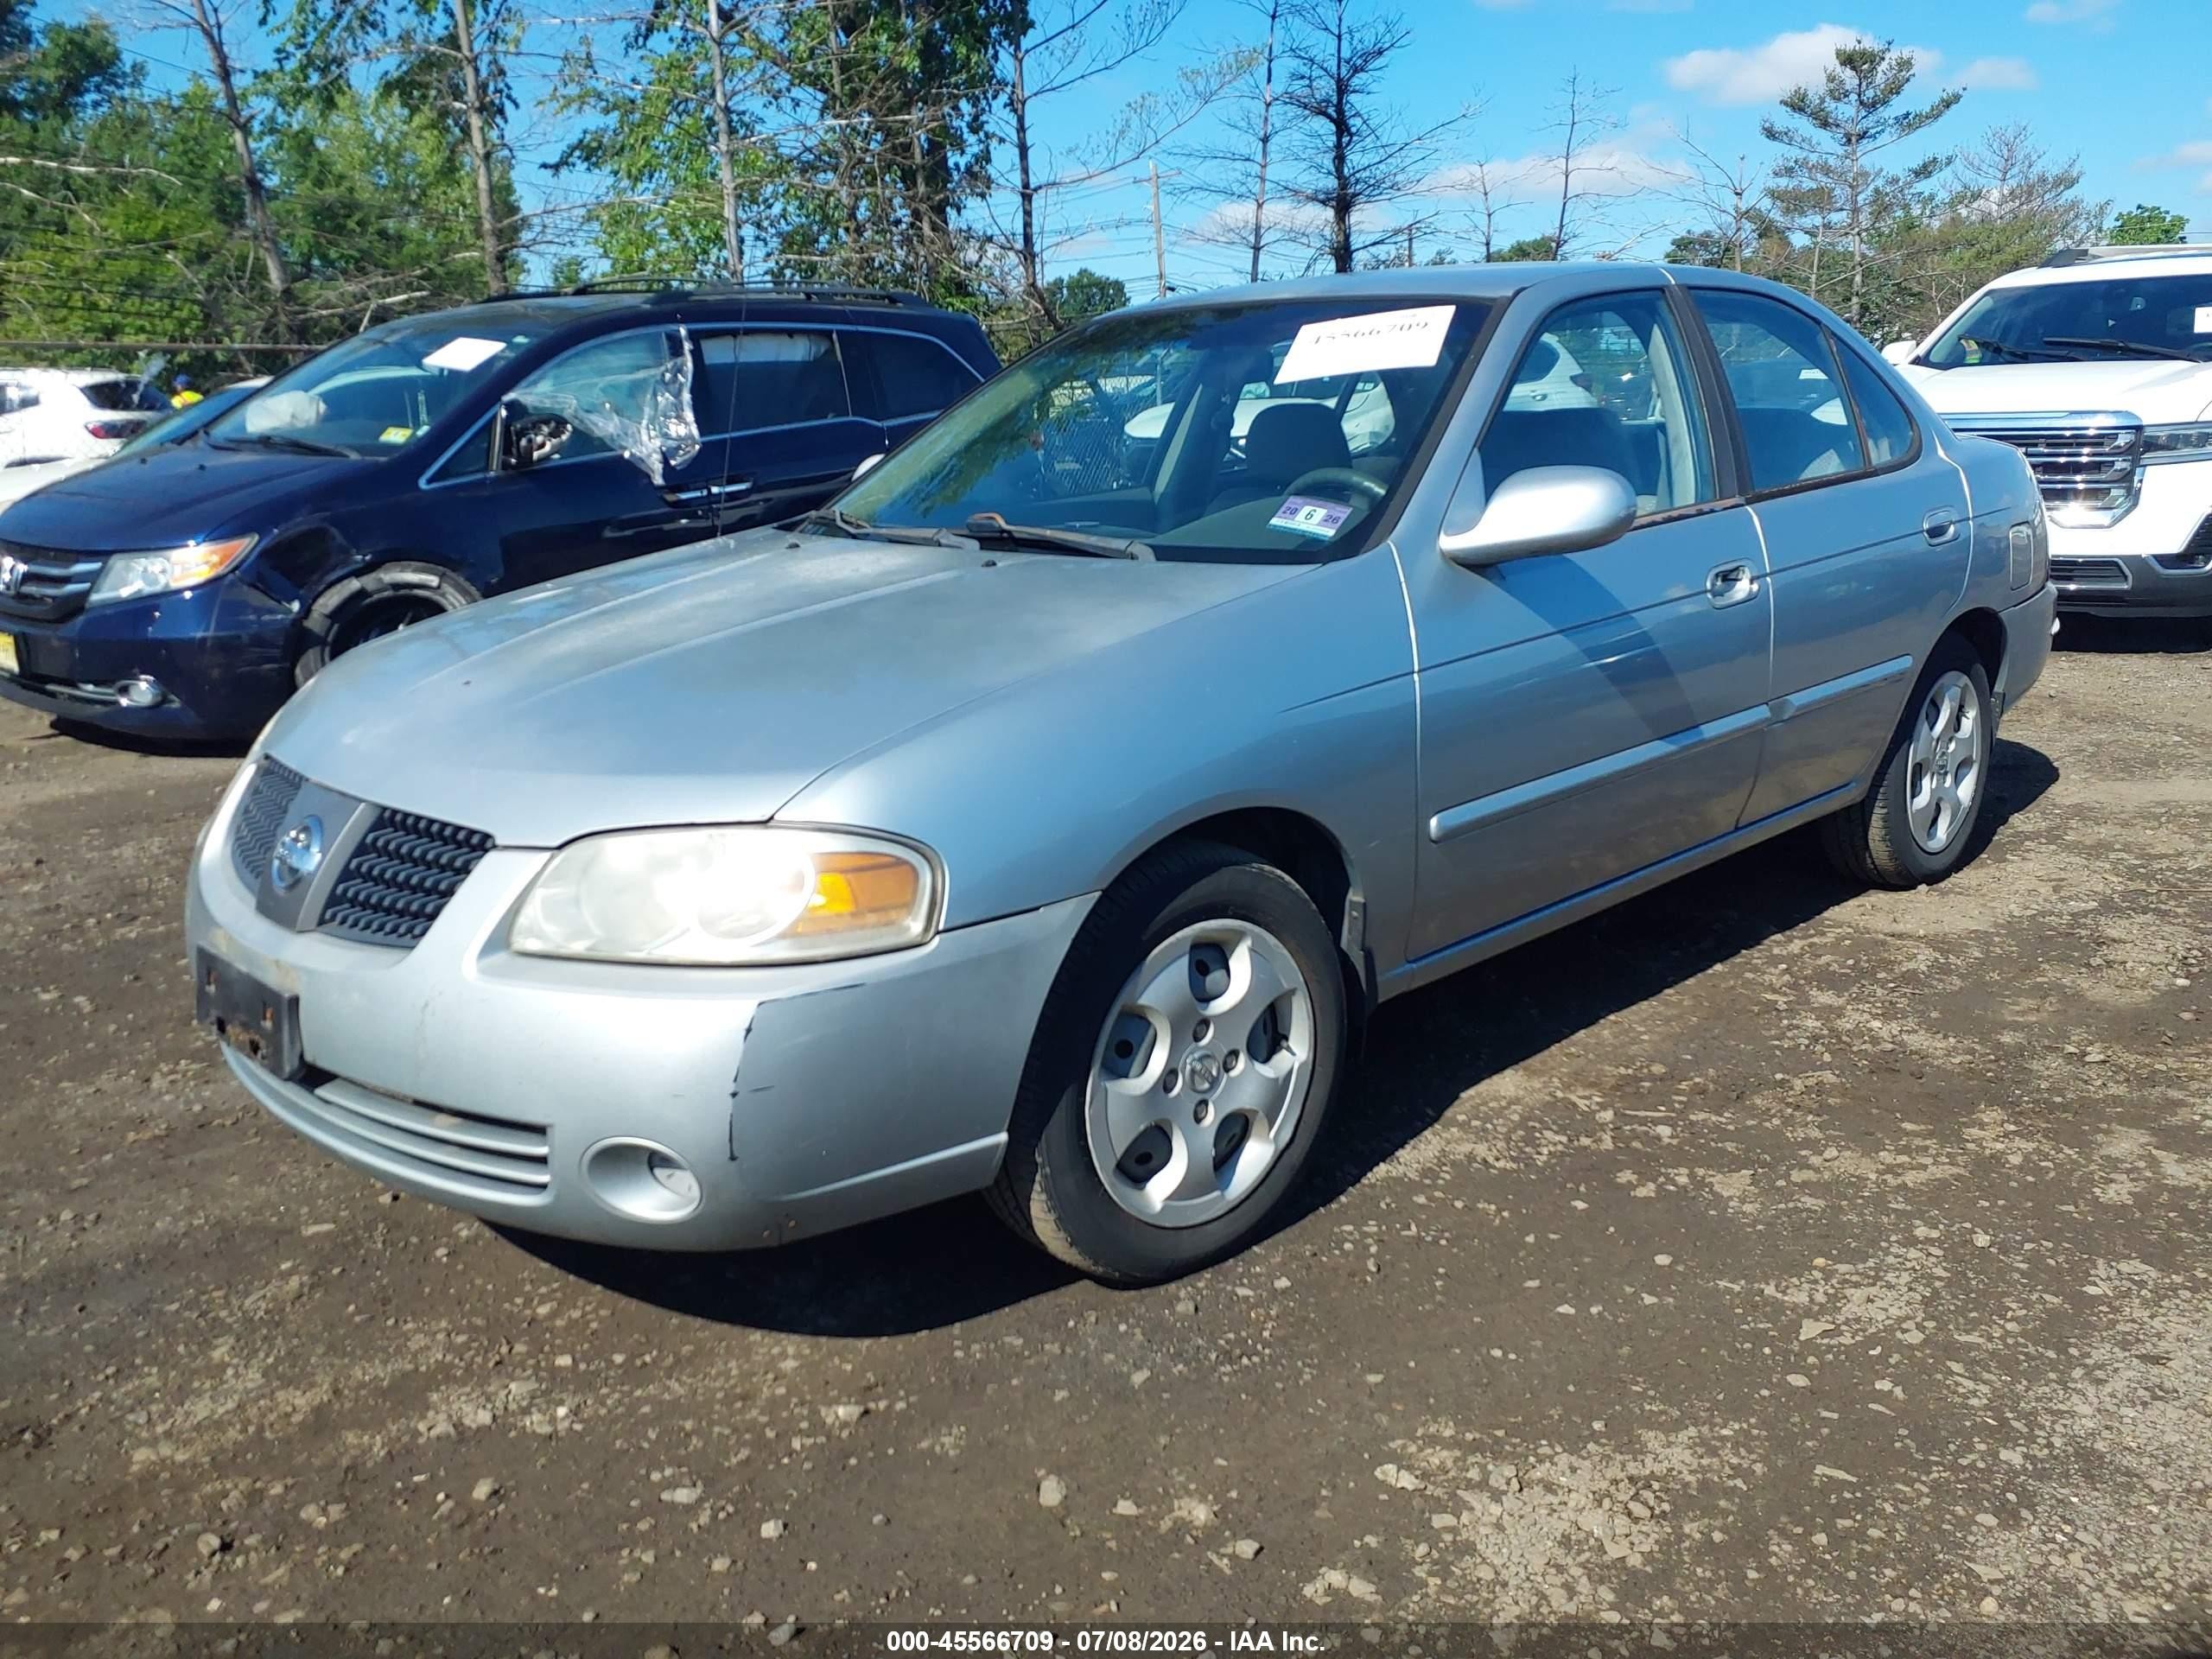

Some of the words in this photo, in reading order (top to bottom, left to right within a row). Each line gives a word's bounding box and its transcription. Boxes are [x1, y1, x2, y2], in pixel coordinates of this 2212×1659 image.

[1281, 505, 1299, 515] 20
[1304, 508, 1317, 521] 6
[1323, 514, 1341, 524] 26
